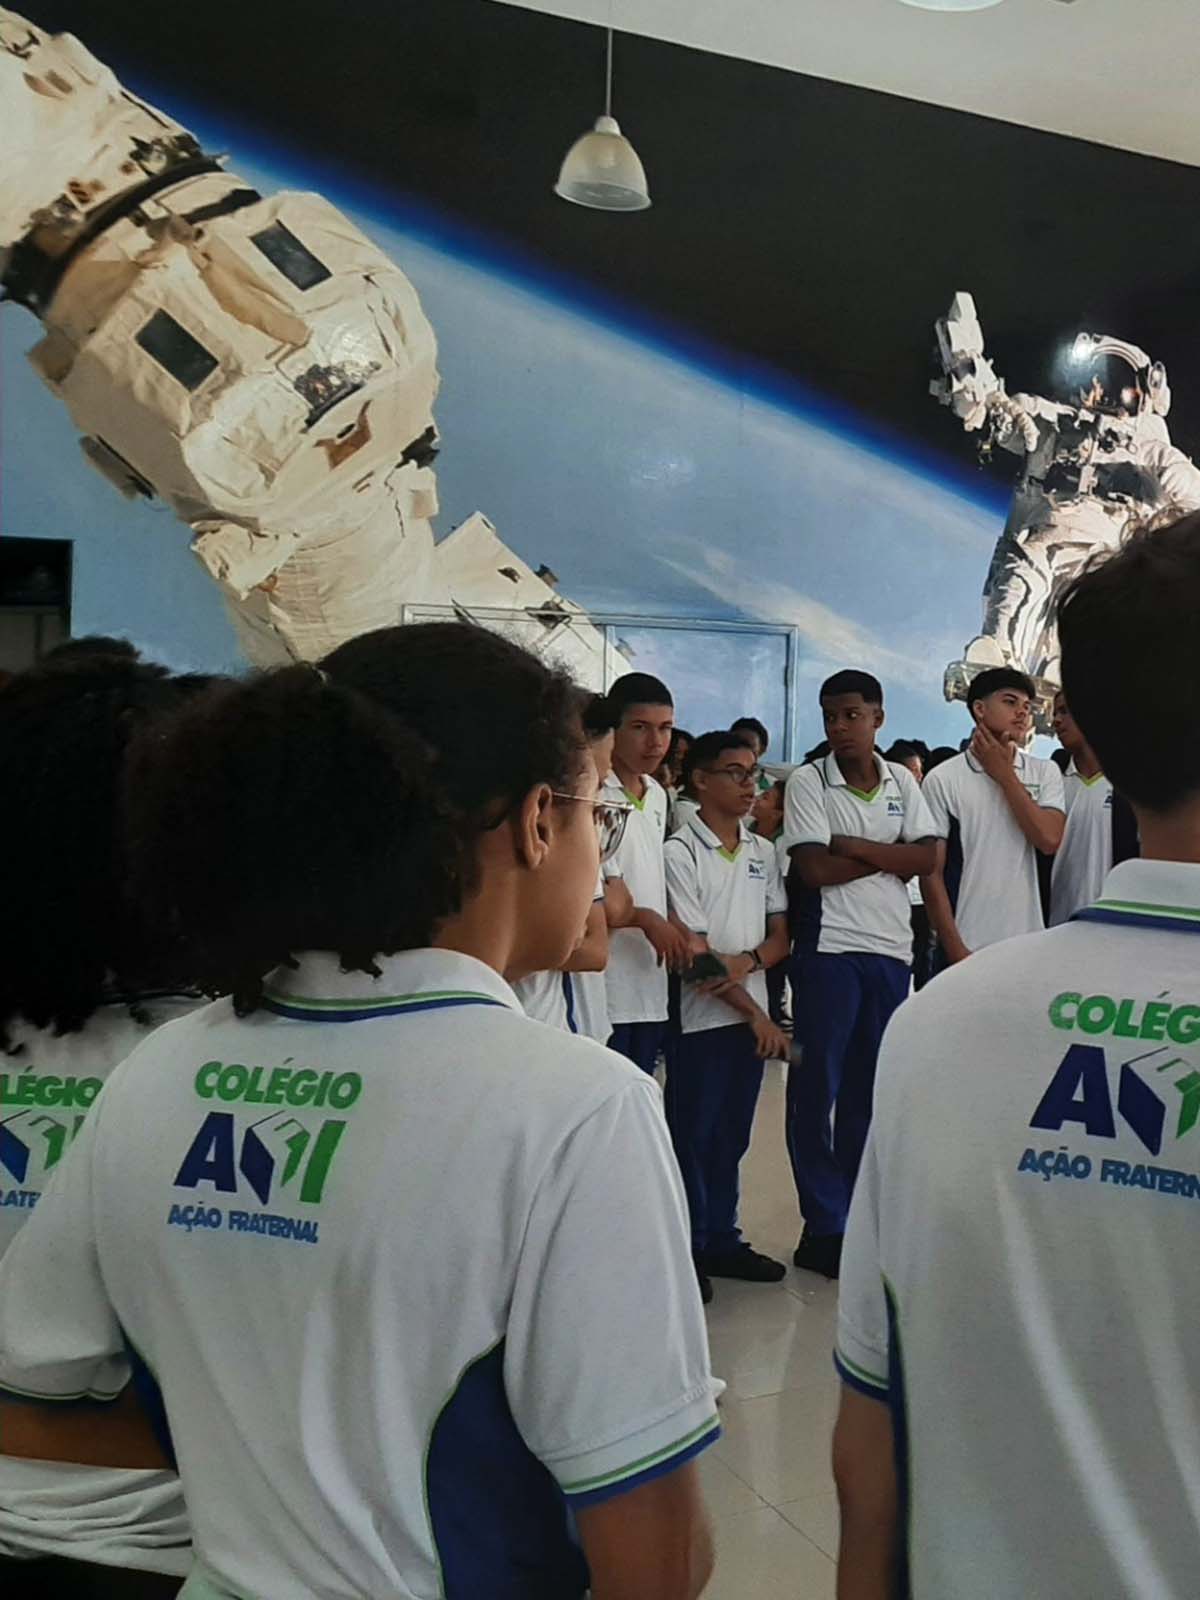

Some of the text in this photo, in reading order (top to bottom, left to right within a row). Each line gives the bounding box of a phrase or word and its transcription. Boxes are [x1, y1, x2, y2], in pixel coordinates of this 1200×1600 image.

[194, 1057, 363, 1109] COLÉGIO
[1017, 1146, 1092, 1182] AÇÃO
[167, 1201, 319, 1244] AÇÃO FRATERNAL
